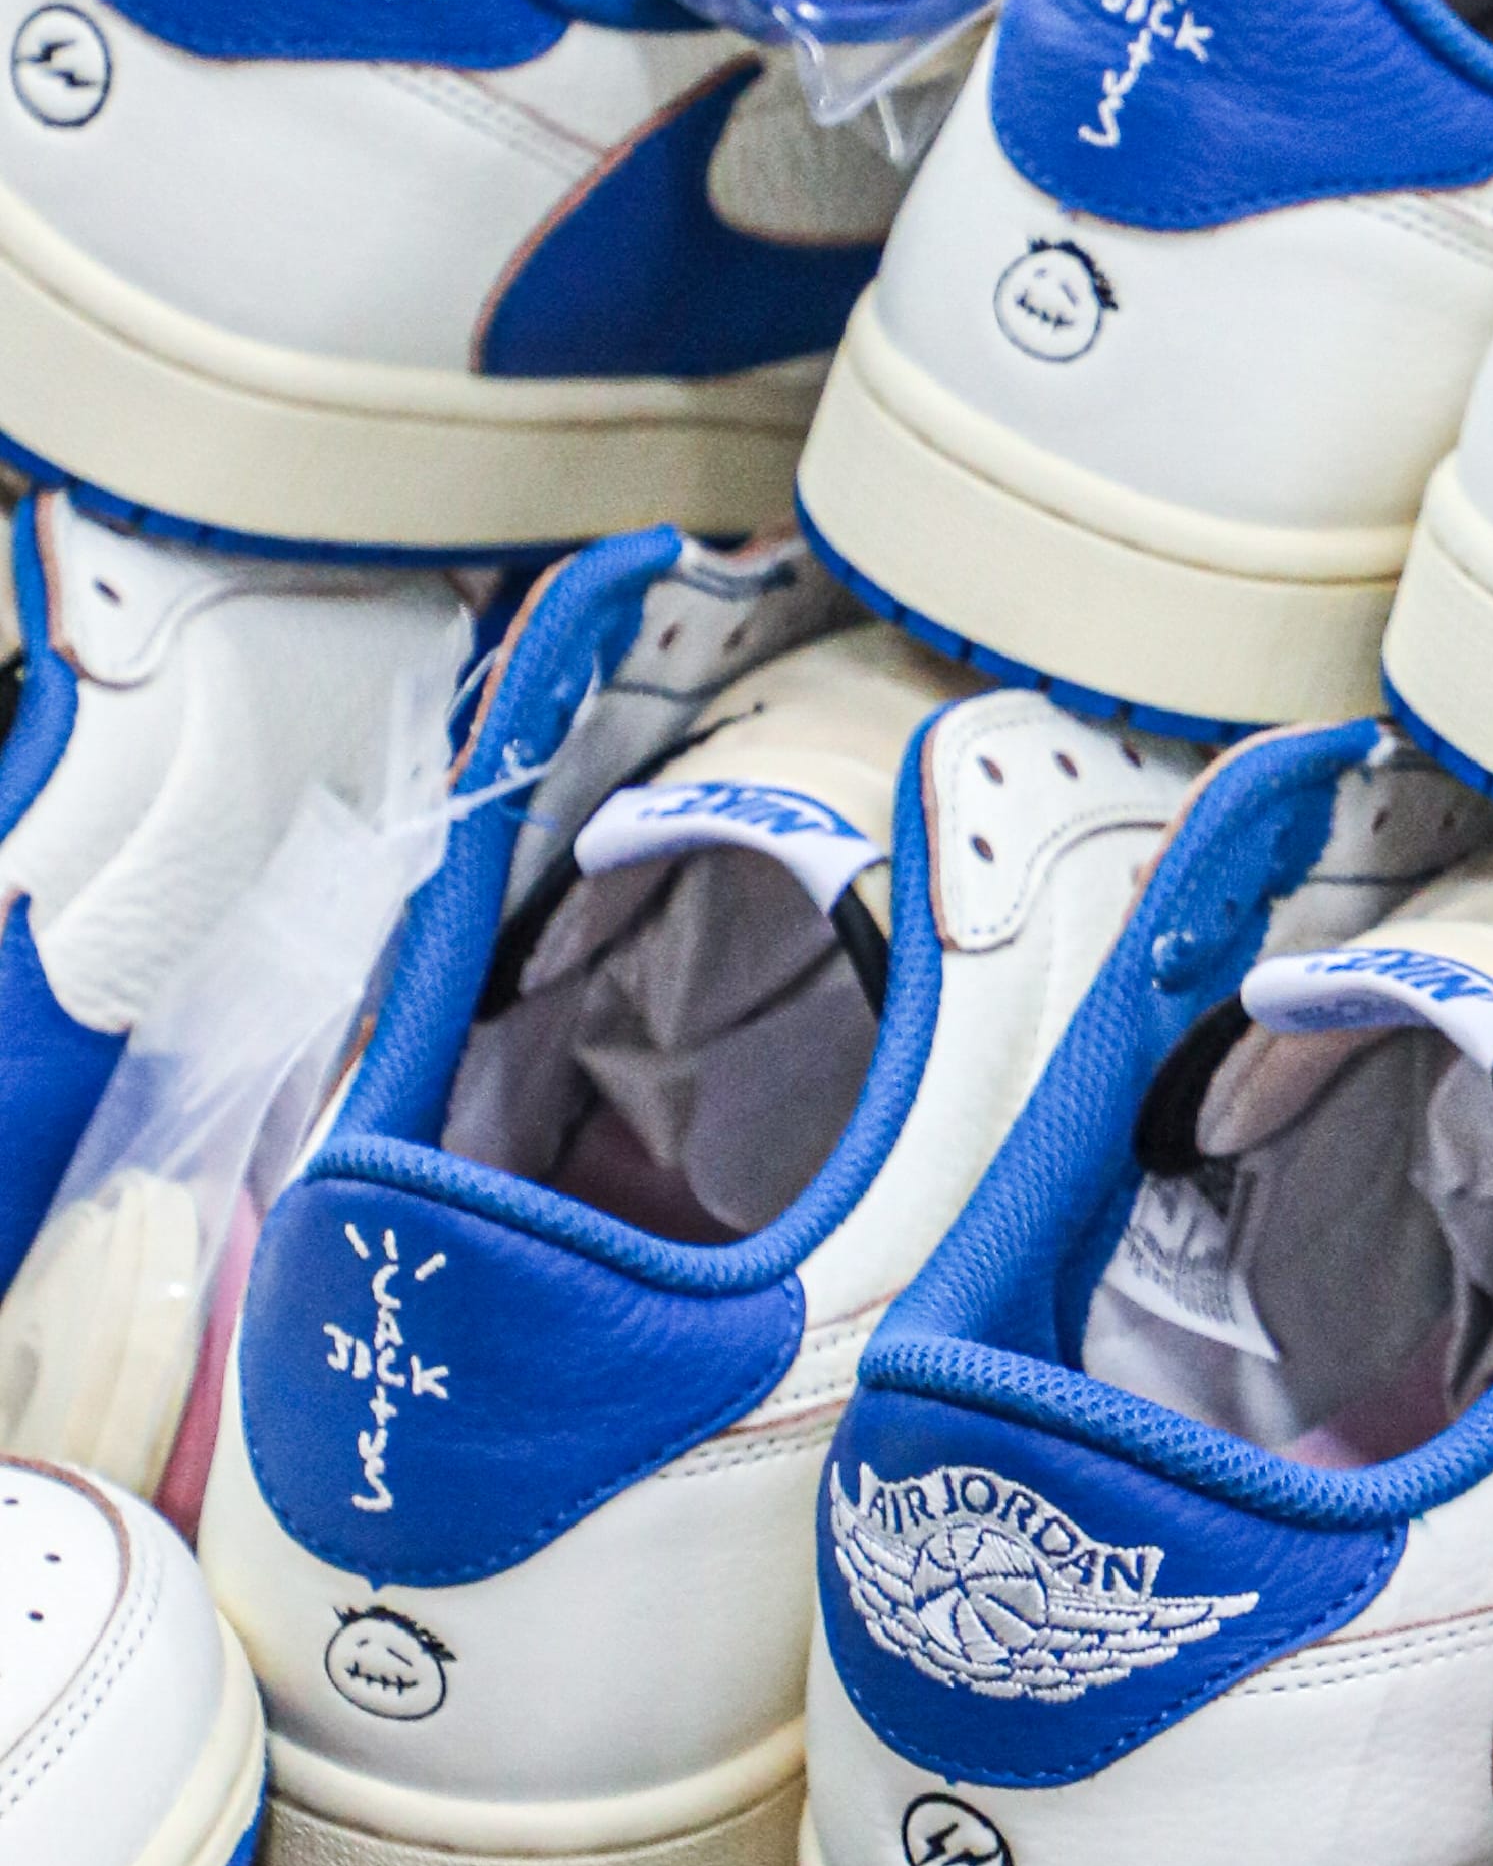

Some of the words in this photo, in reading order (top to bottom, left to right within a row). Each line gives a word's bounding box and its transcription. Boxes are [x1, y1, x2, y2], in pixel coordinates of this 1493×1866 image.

[1326, 949, 1491, 1001] NIKE
[868, 1485, 936, 1534] AIR
[942, 1472, 1145, 1592] JORDAN
